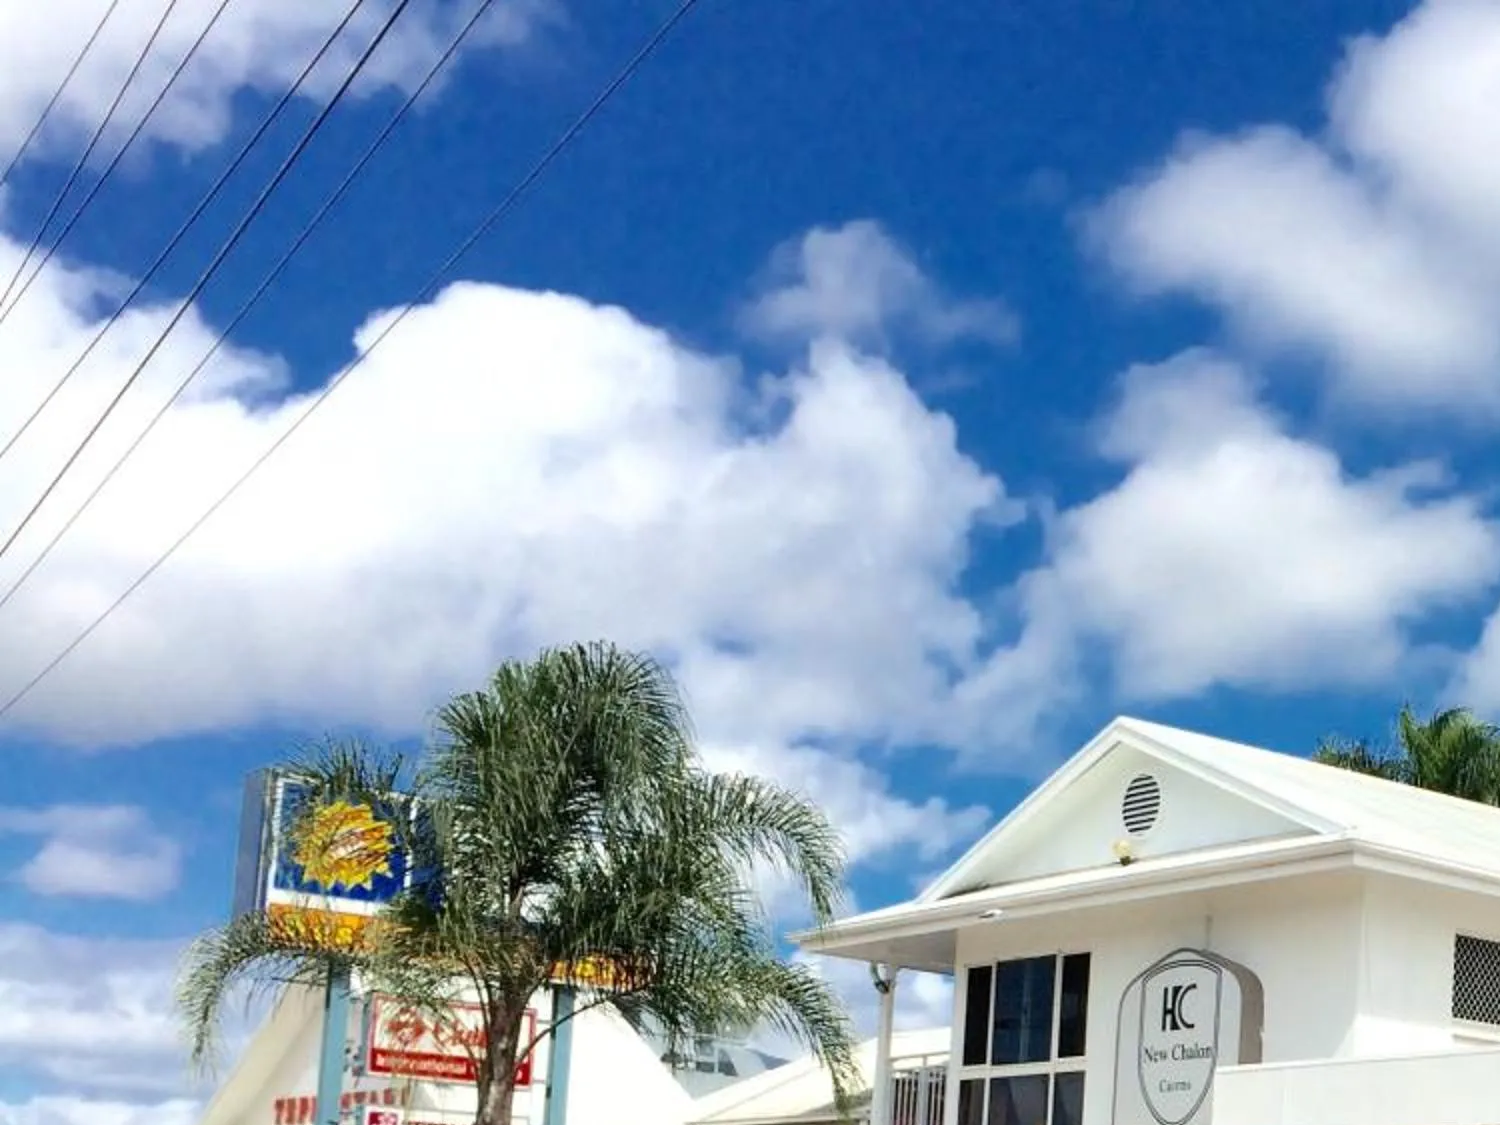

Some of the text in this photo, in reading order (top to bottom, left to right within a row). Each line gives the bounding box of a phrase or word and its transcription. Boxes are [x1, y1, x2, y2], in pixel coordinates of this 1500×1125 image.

[1144, 1043, 1214, 1062] New Chalon
[1159, 1079, 1192, 1093] Cairns
